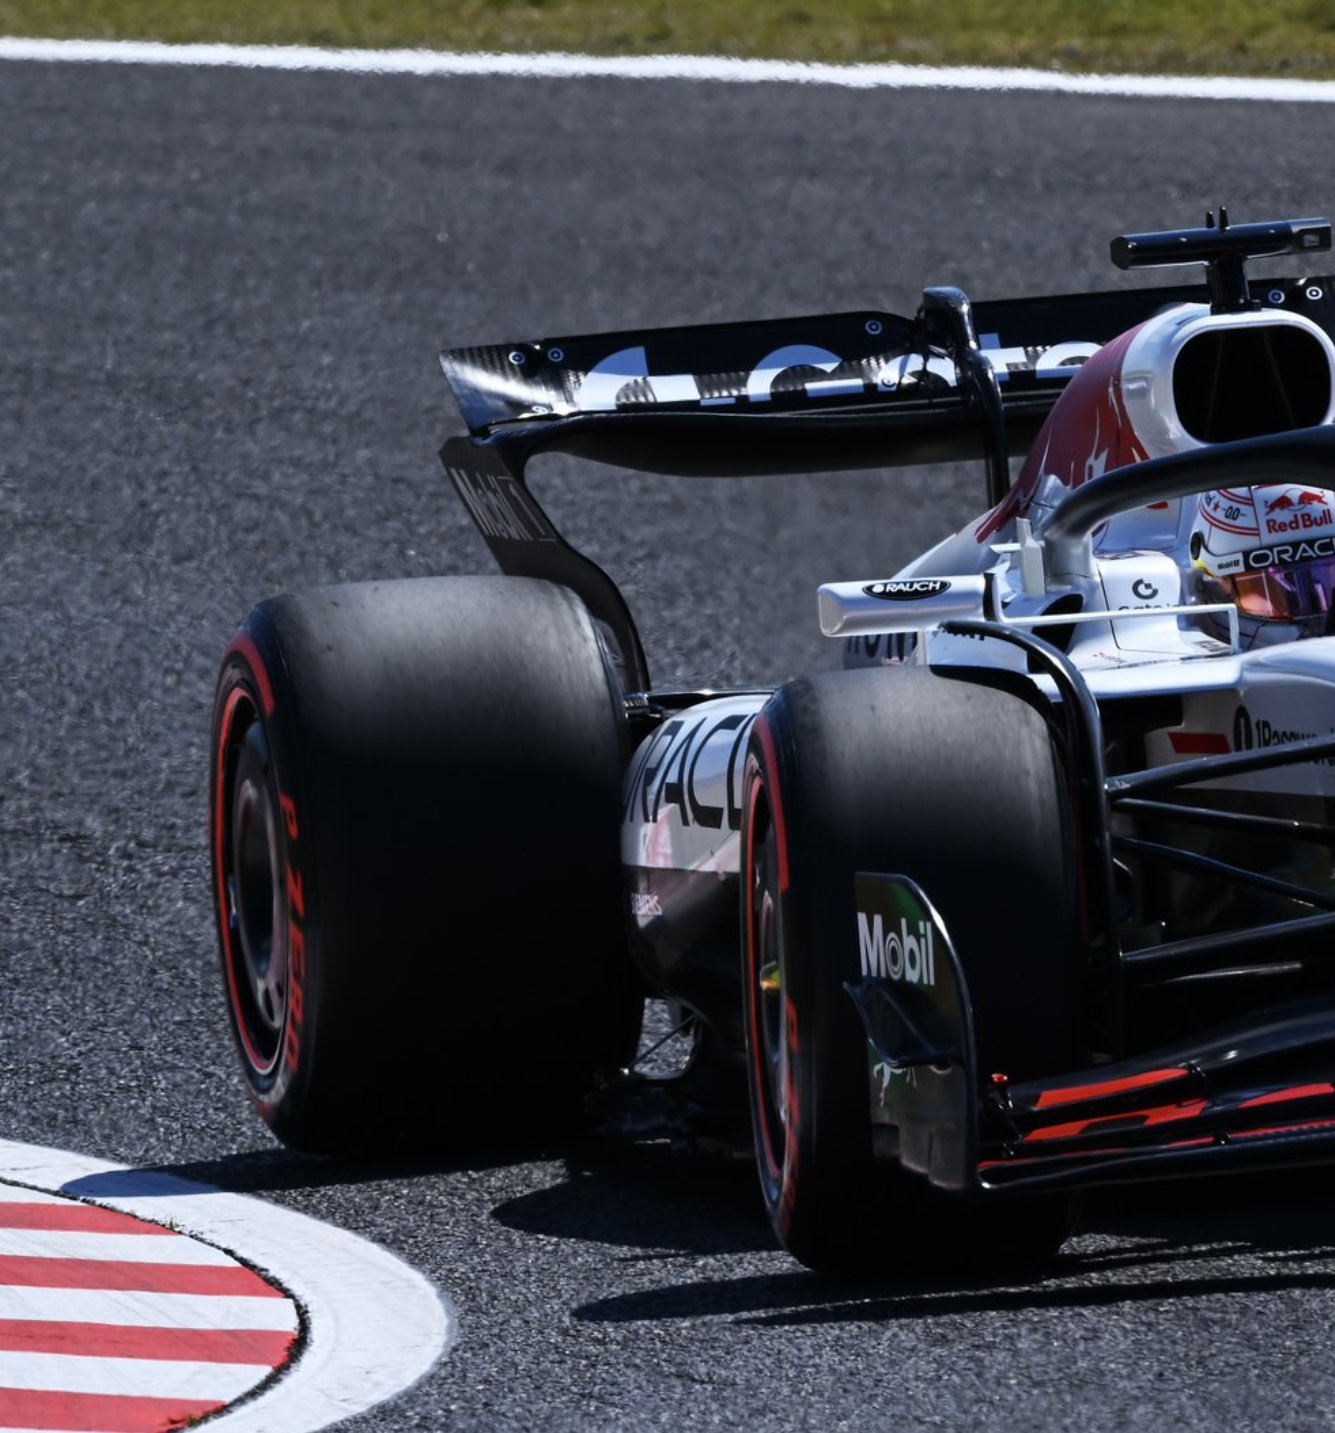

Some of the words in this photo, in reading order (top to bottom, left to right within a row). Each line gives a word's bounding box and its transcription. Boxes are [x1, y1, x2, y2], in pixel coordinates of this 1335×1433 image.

[1266, 514, 1300, 534] Red
[1301, 509, 1333, 528] Bull
[885, 581, 942, 593] RAUCH
[857, 910, 936, 987] Mobil
